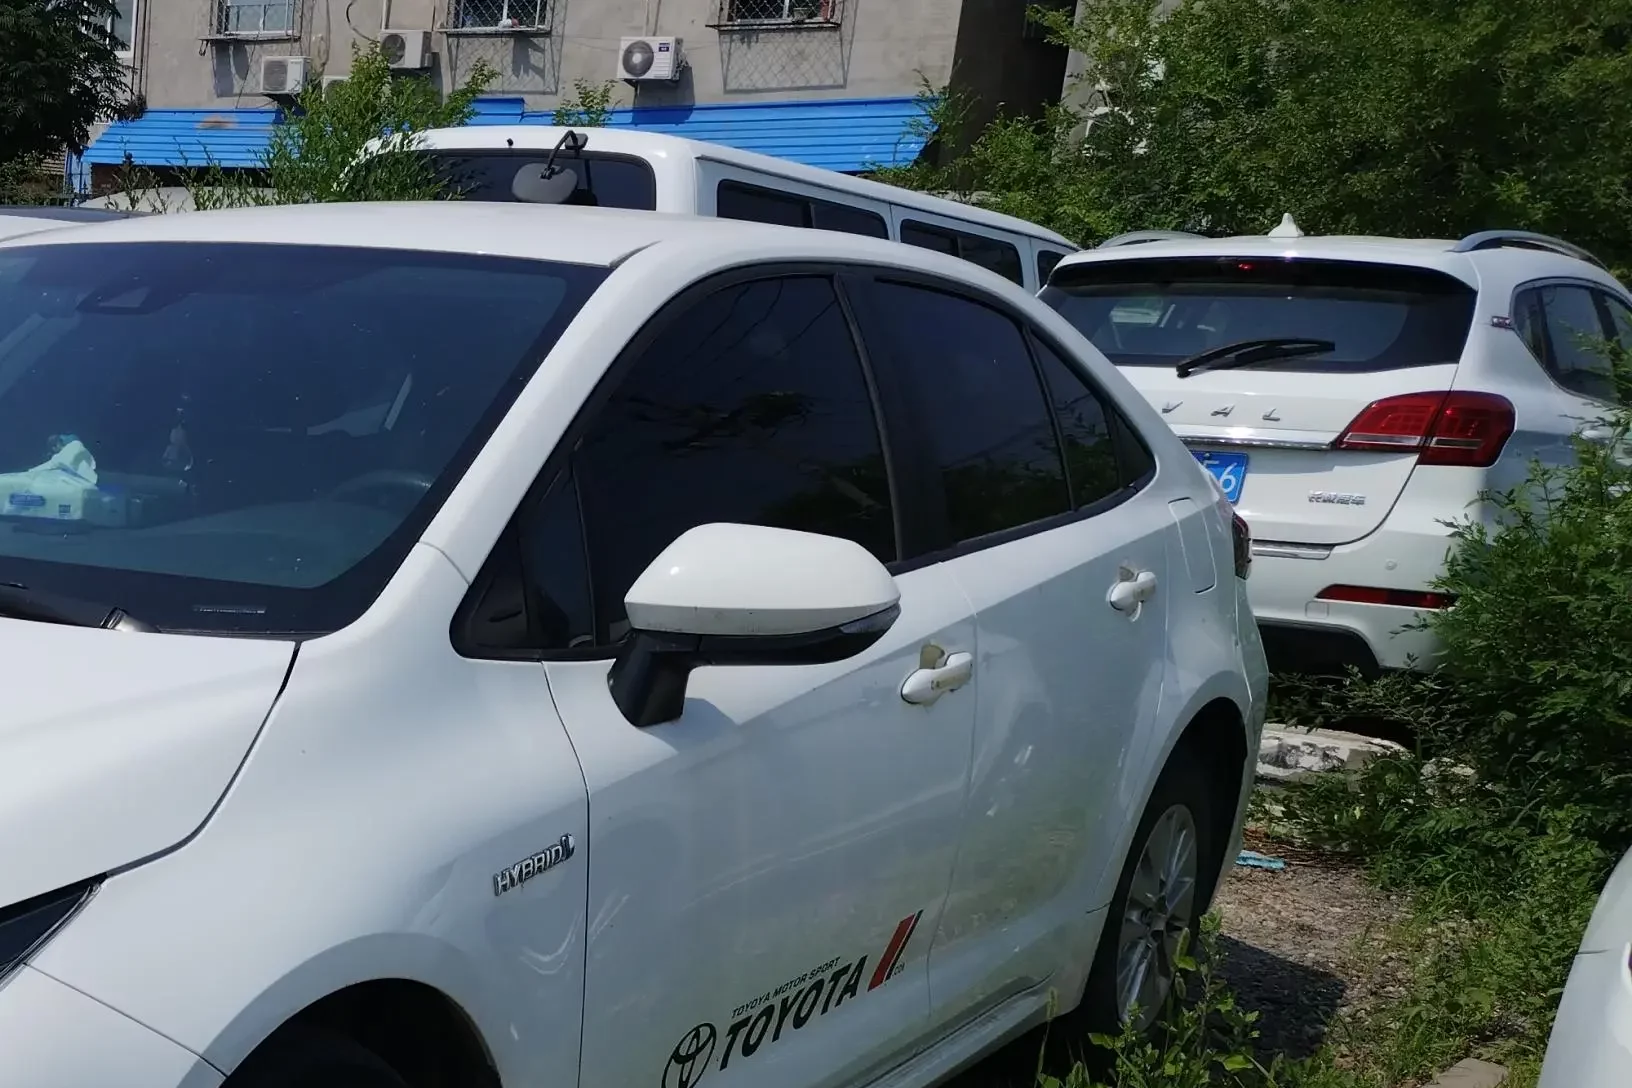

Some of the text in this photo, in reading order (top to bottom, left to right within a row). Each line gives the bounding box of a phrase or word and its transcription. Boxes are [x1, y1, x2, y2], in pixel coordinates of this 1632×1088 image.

[493, 844, 563, 896] HYBRID
[772, 973, 807, 998] MOTOR
[808, 956, 841, 980] SPORT
[719, 954, 868, 1072] TOYOTA
